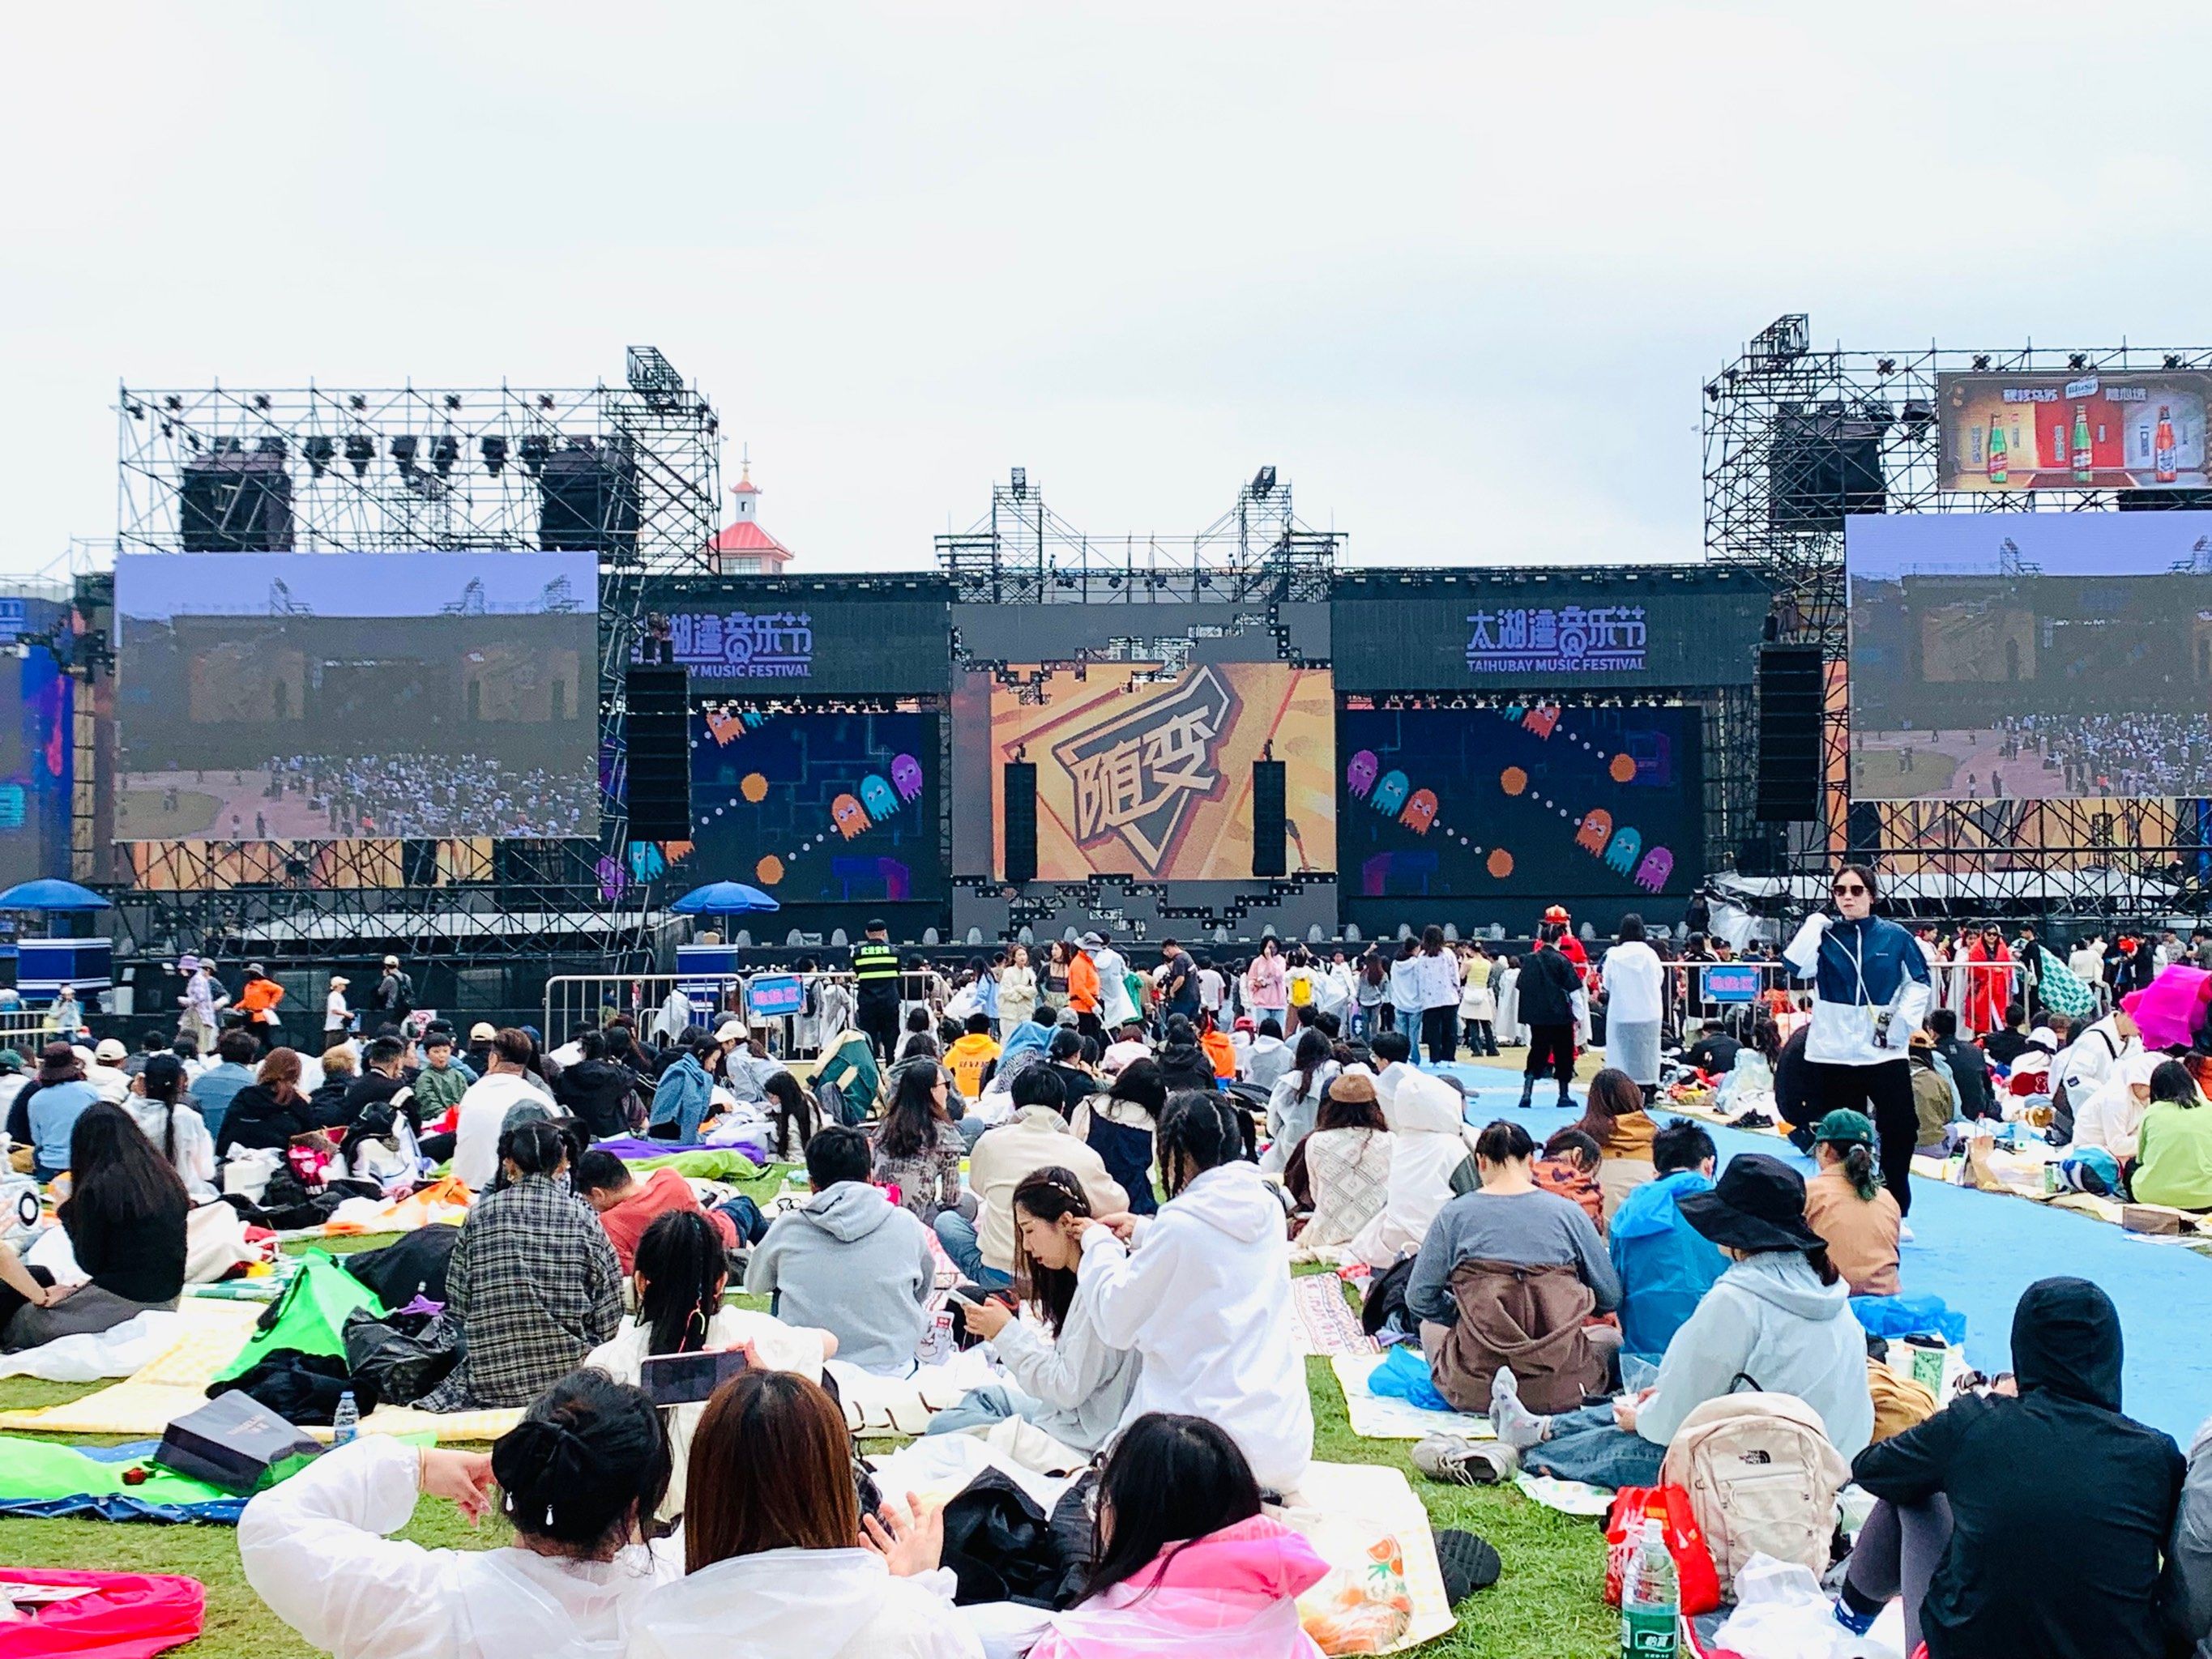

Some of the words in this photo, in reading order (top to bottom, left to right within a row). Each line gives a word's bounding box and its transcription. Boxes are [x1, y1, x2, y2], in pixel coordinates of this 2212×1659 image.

[648, 612, 812, 663] 湖湾音乐节
[701, 664, 745, 677] MUSIC
[748, 663, 812, 677] FESTIVAL
[1467, 659, 1533, 672] TAIHUBAY
[1535, 659, 1580, 672] MUSIC
[1582, 657, 1646, 671] FESTIVAL
[1069, 705, 1217, 839] 随变
